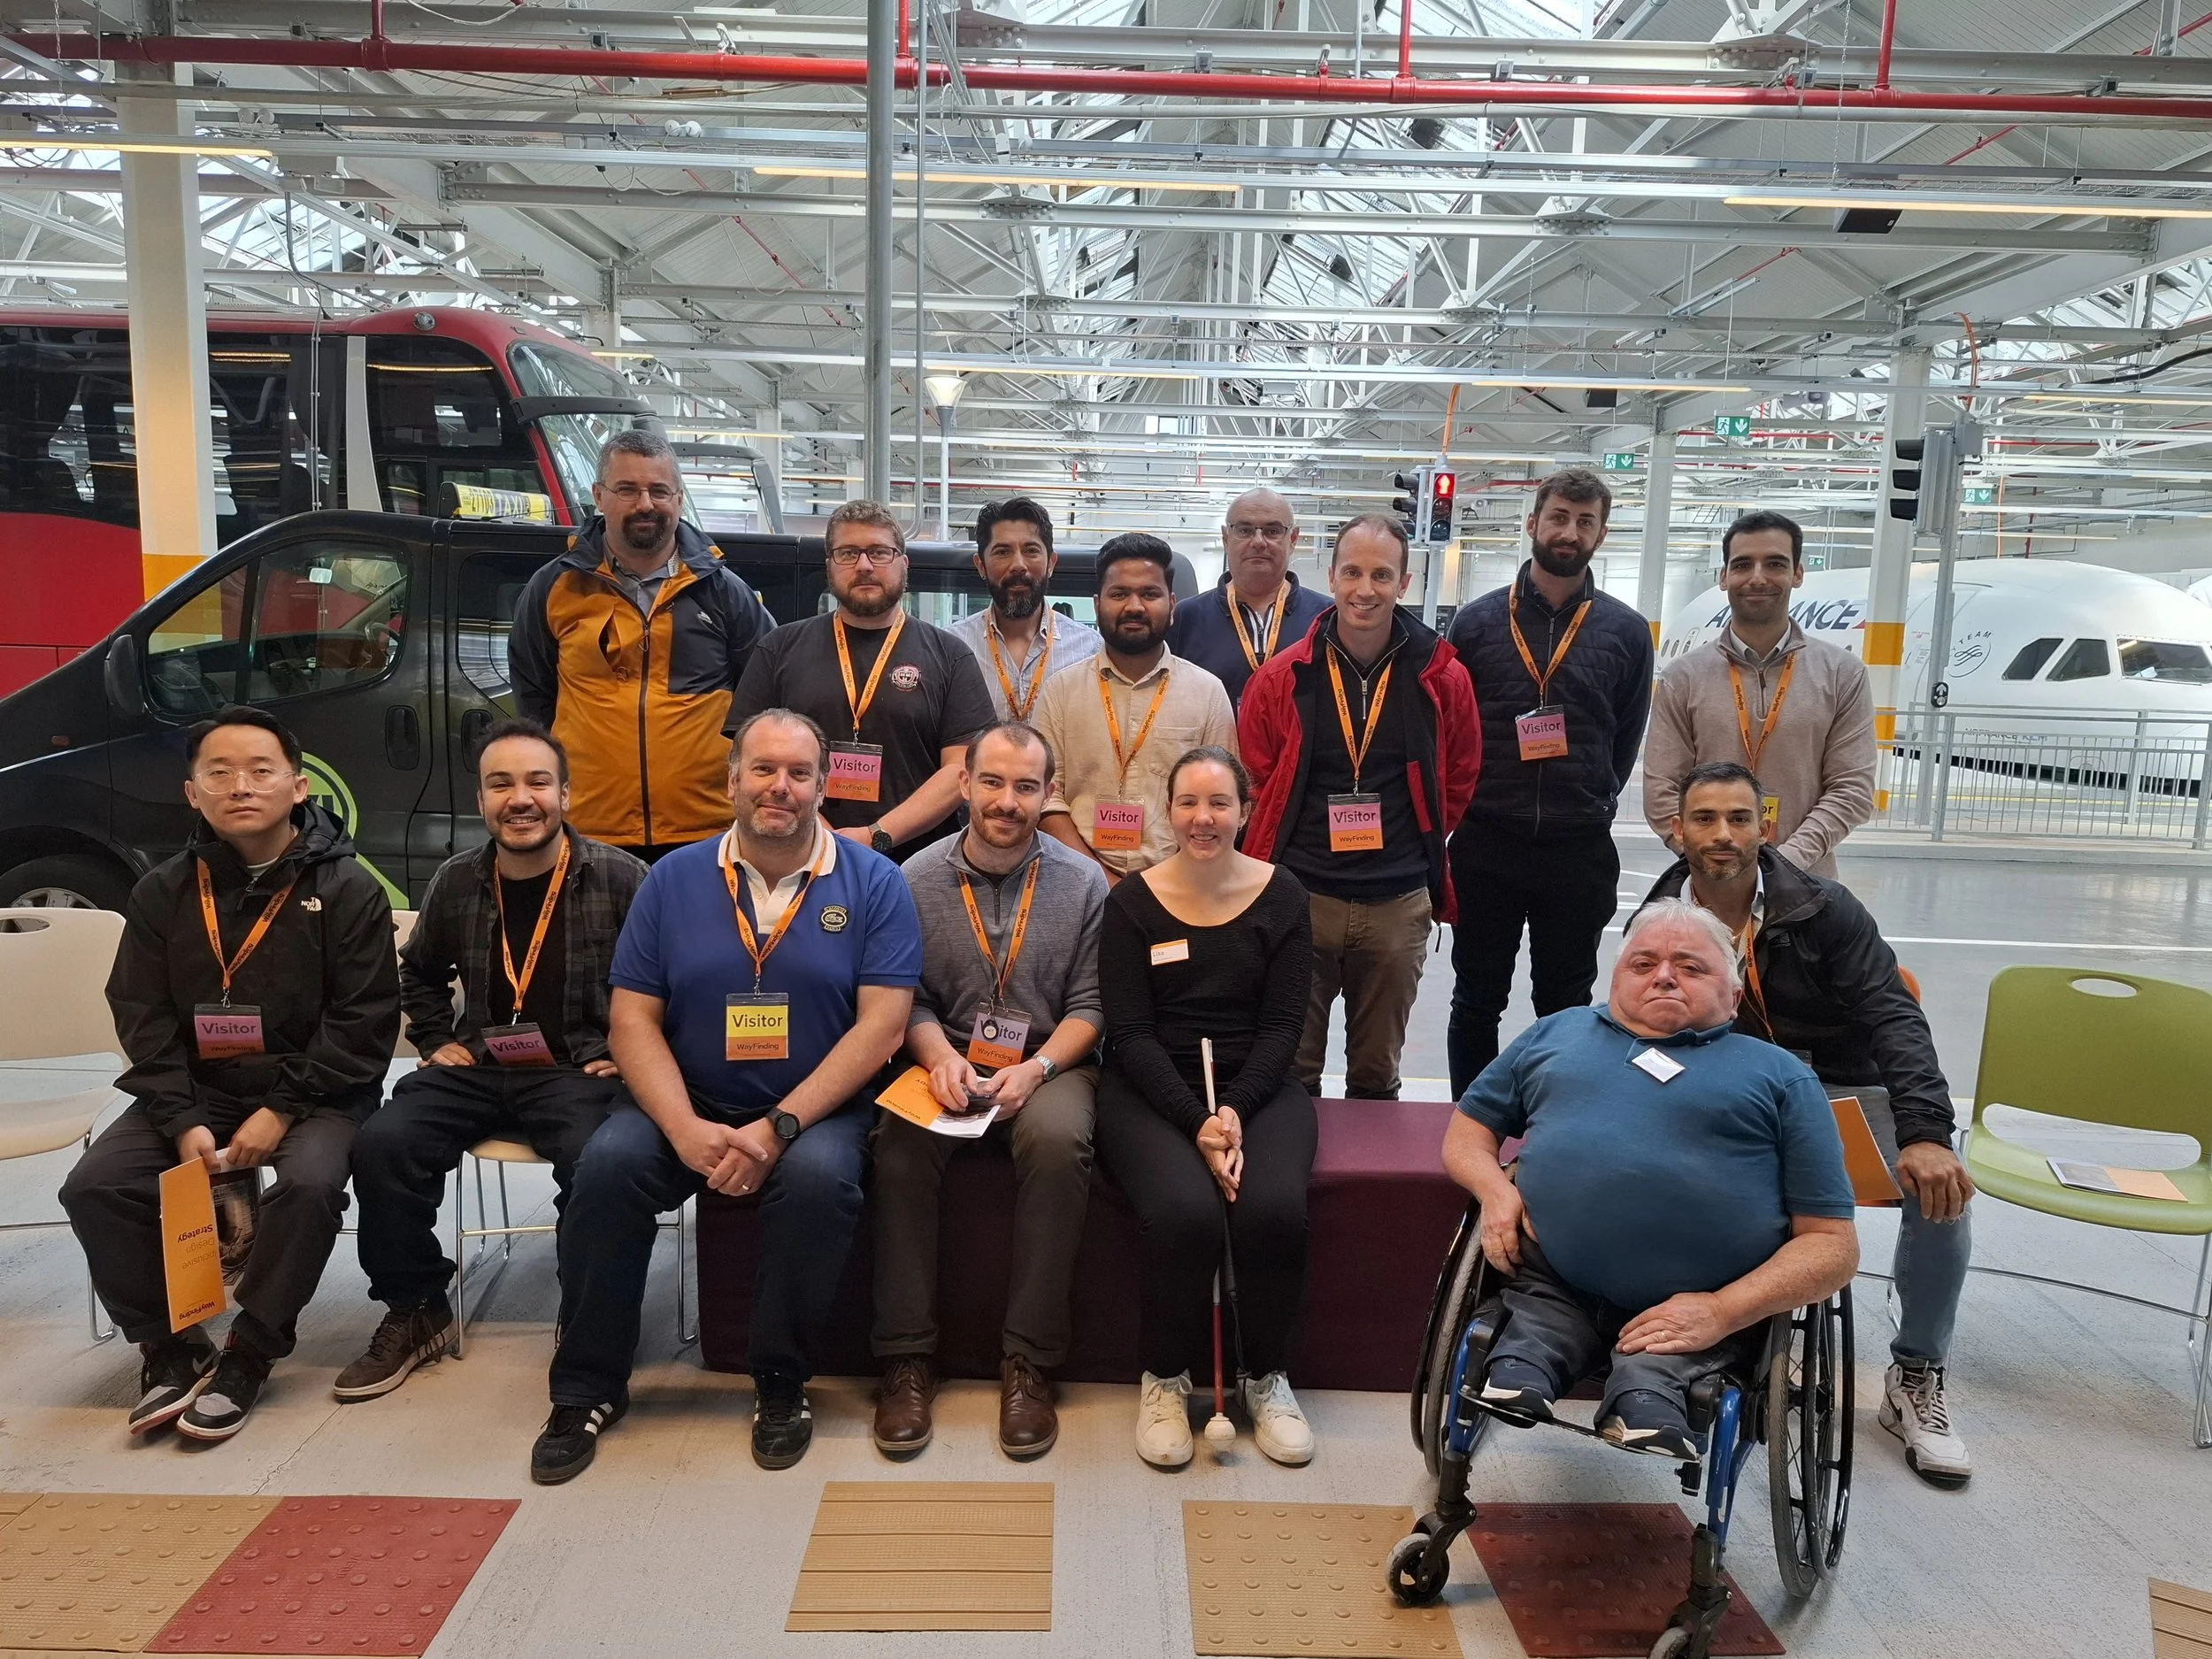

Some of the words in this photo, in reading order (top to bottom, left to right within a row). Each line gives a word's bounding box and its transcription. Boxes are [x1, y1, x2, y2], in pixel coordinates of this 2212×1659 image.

[1521, 722, 1561, 734] Visitor
[833, 758, 876, 772] Visitor
[835, 783, 872, 792] WayFinding
[1099, 810, 1139, 823] Visitor
[1333, 810, 1376, 823] Visitor
[1101, 833, 1134, 843] WayFinding
[1339, 834, 1375, 843] WayFinding
[1026, 861, 1038, 889] WayFinding
[263, 893, 285, 923] WayFinding
[542, 891, 557, 920] WayFinding
[970, 903, 981, 934] WayFinding
[1016, 908, 1027, 938] WayFinding
[761, 928, 782, 958] WayFinding
[526, 940, 540, 970] WayFinding
[202, 1023, 257, 1033] Visitor
[733, 1014, 783, 1027] Visitor
[980, 1020, 1022, 1041] itor
[492, 1040, 540, 1052] Visitor
[736, 1042, 780, 1051] WayFinding
[977, 1048, 1013, 1062] WayFinding
[177, 1224, 213, 1243] Strategy
[186, 1237, 215, 1253] Design
[182, 1251, 217, 1269] Inclusive
[179, 1301, 215, 1320] WayFinding
